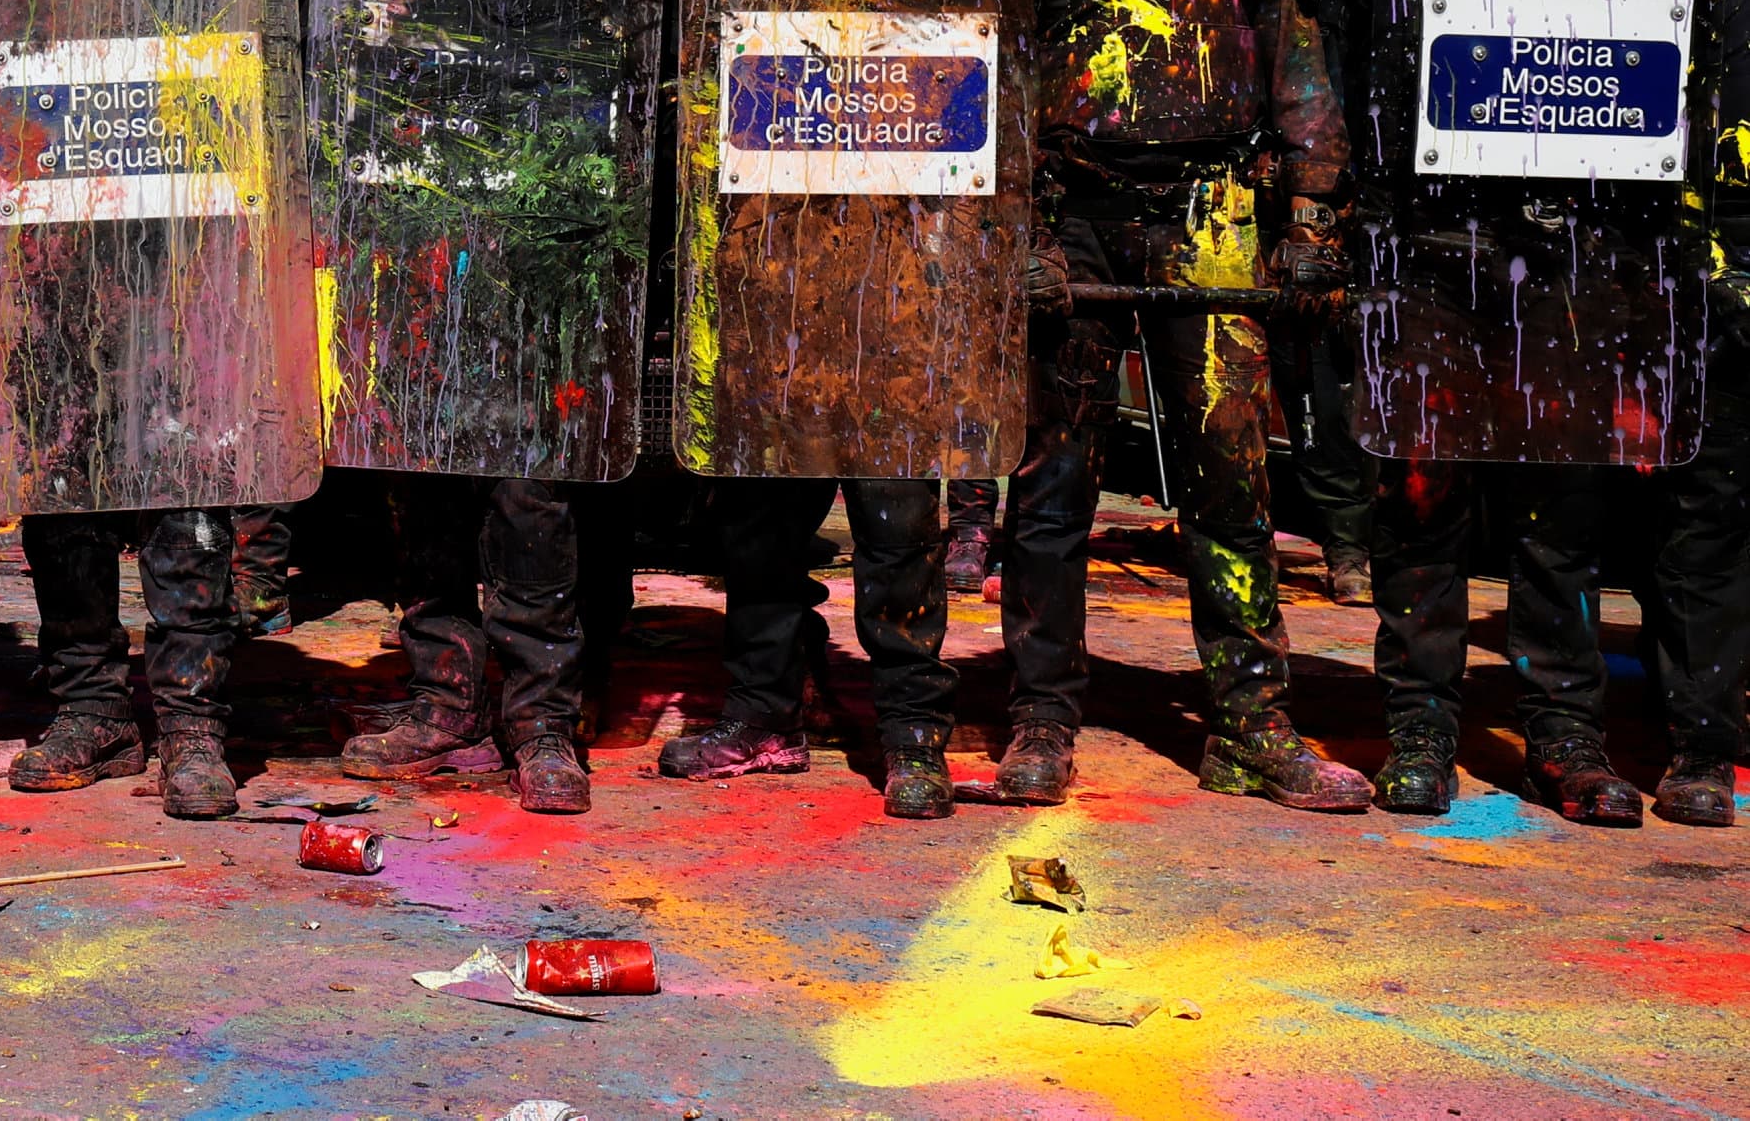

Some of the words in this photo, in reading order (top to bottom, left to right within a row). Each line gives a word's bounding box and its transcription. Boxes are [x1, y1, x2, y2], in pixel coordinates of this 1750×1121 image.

[1511, 38, 1614, 67] Policia
[802, 57, 909, 84] Policia
[1502, 67, 1621, 97] Mossos
[71, 81, 174, 111] Policia
[794, 86, 917, 114] Mossos
[1472, 96, 1645, 132] d'Esquadra
[765, 117, 944, 150] d'Esquadra
